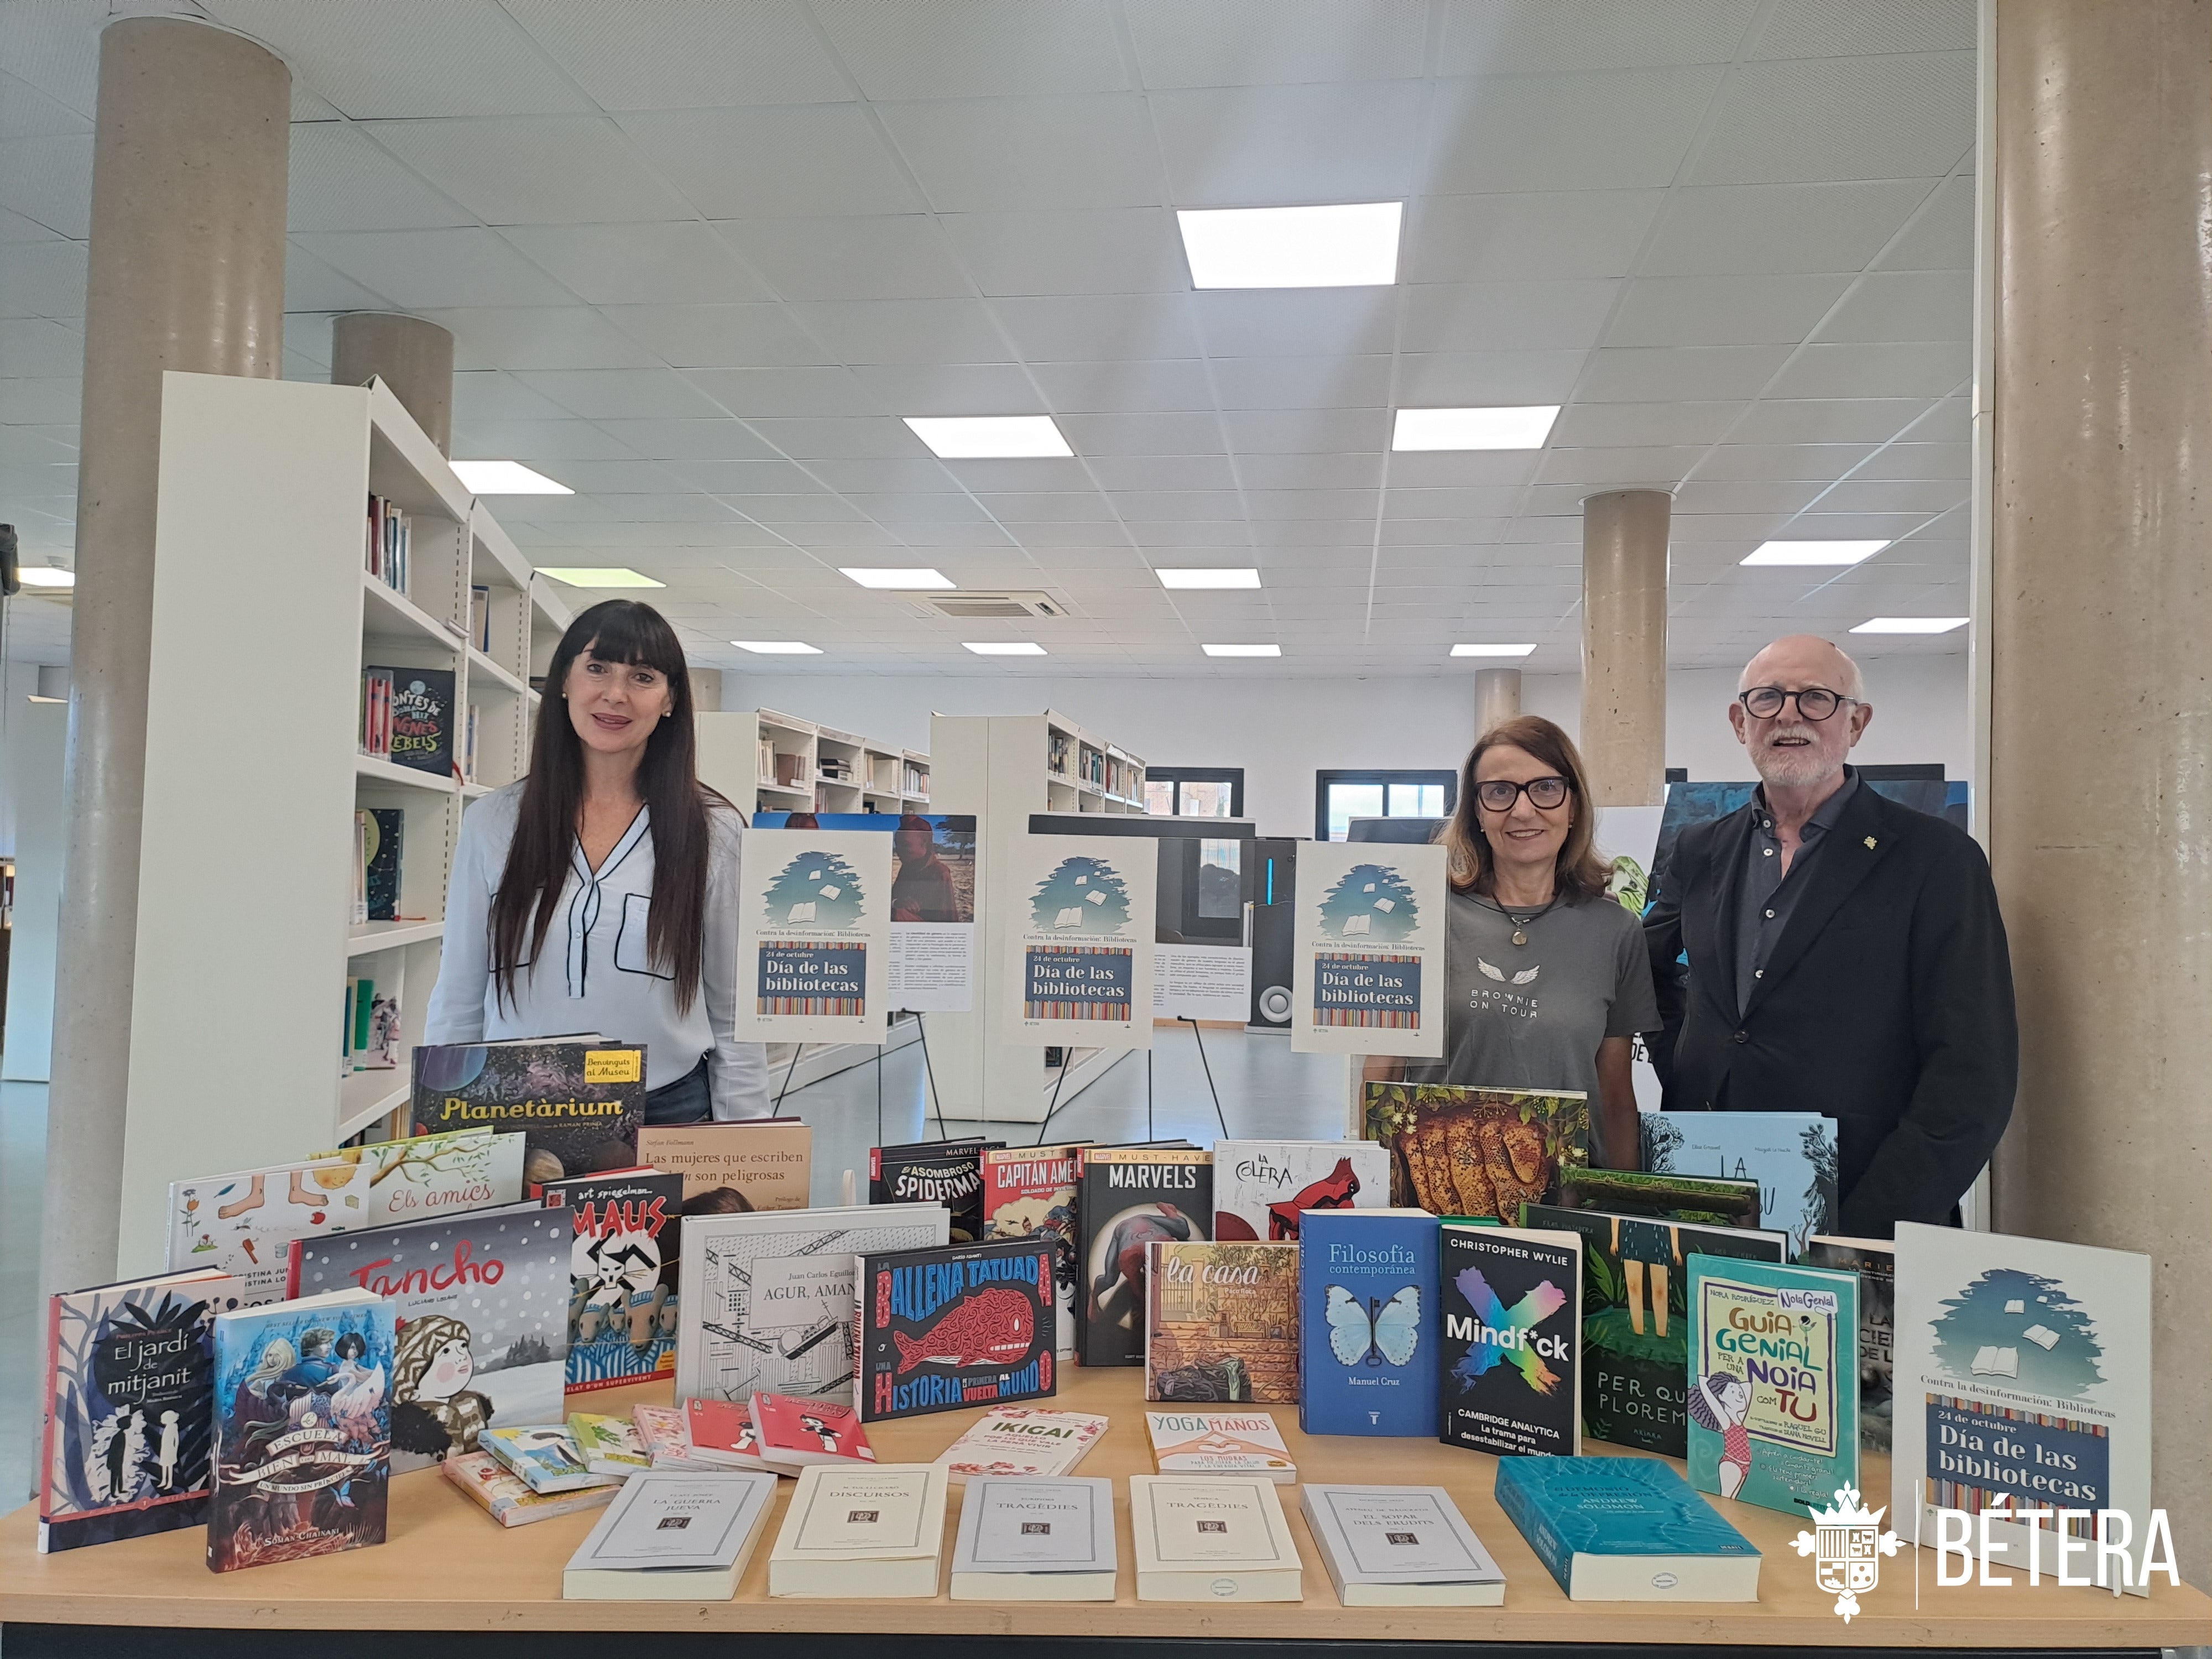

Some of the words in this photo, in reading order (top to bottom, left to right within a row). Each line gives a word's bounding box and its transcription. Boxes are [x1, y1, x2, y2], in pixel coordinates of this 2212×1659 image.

[392, 690, 429, 711] ONTES
[392, 730, 442, 752] EBELS
[766, 961, 794, 974] Día
[799, 961, 818, 974] de
[823, 961, 848, 974] las
[1034, 964, 1061, 978] Día
[1066, 966, 1085, 979] de
[1089, 966, 1114, 980] las
[766, 977, 858, 992] bibliotecas
[1323, 972, 1349, 985] Día
[1355, 973, 1374, 987] de
[1378, 974, 1403, 988] las
[1033, 982, 1124, 997] bibliotecas
[1322, 989, 1413, 1005] bibliotecas
[1472, 989, 1537, 1007] BROWNIE
[1470, 1000, 1488, 1009] ON
[1502, 1004, 1537, 1018] TOUR
[587, 1058, 630, 1068] Benvinguts
[600, 1068, 630, 1076] Museu
[440, 1097, 624, 1120] Planetàrium
[646, 1152, 666, 1164] Las
[671, 1153, 720, 1166] mujeres
[723, 1154, 747, 1166] que
[751, 1151, 803, 1162] escriben
[946, 1147, 978, 1156] MARVEL
[1259, 1153, 1268, 1165] LA
[695, 1172, 717, 1181] son
[722, 1170, 785, 1184] peligrosas
[912, 1161, 974, 1177] ASOMBROSO
[998, 1160, 1047, 1188] CAPITÁN
[1051, 1157, 1077, 1185] AMÉ
[1109, 1165, 1196, 1188] MARVELS
[389, 1190, 419, 1212] Els
[425, 1180, 495, 1207] amics
[578, 1188, 594, 1199] art
[597, 1185, 653, 1199] spiegelman
[573, 1196, 667, 1241] MAUS
[1329, 1244, 1416, 1263] Filosofía
[1451, 1238, 1528, 1259] CHRISTOPHER
[1533, 1251, 1568, 1266] WYLIE
[349, 1239, 504, 1298] Tancho
[877, 1262, 890, 1271] LA
[1167, 1256, 1197, 1283] la
[1202, 1264, 1261, 1285] casa
[1329, 1264, 1416, 1278] contemporánea
[1839, 1258, 1893, 1271] MARIE
[764, 1286, 810, 1300] AGUR,
[875, 1262, 964, 1328] BALLENA
[967, 1254, 1052, 1307] TATUADA
[1710, 1290, 1729, 1300] NORA
[1731, 1293, 1775, 1306] RODRÍGUEZ
[1870, 1313, 1892, 1328] LA
[114, 1342, 132, 1360] El
[129, 1328, 189, 1373] jardí
[1718, 1352, 1734, 1363] PER
[143, 1358, 158, 1370] de
[876, 1362, 891, 1371] UNA
[1726, 1363, 1744, 1374] UNA
[606, 1375, 651, 1387] SUPERVIVENT
[999, 1350, 1052, 1396] MUNDO
[1348, 1376, 1379, 1386] Manuel
[1381, 1376, 1400, 1387] Cruz
[108, 1368, 192, 1405] mitjanit
[874, 1372, 963, 1414] HISTORIA
[963, 1385, 999, 1402] VUELTA
[1598, 1371, 1645, 1397] PER
[1656, 1386, 1686, 1404] QU
[1757, 1395, 1777, 1405] COM
[1775, 1388, 1817, 1422] TU
[1921, 1375, 1954, 1389] Contra
[1958, 1380, 1967, 1391] la
[1970, 1383, 2052, 1407] desinformación:
[2057, 1400, 2116, 1419] Bibliotecas
[1600, 1393, 1686, 1426] PLOREM
[992, 1422, 1074, 1439] IKIGAI
[1152, 1416, 1209, 1431] YOGA
[1208, 1419, 1270, 1431] MANOS
[1458, 1408, 1510, 1427] CAMBRIDGE
[1511, 1420, 1560, 1439] ANALYTICA
[1784, 1421, 1812, 1432] RAQUEL
[1938, 1410, 1952, 1421] 24
[1954, 1412, 1968, 1424] de
[1971, 1417, 2017, 1434] octubre
[274, 1430, 343, 1451] ESCUELA
[1460, 1431, 1517, 1451] desestabilizar
[1518, 1445, 1526, 1453] el
[1481, 1424, 1490, 1433] La
[1492, 1427, 1516, 1439] trama
[1517, 1434, 1536, 1445] para
[1802, 1433, 1827, 1443] NOVELL
[1939, 1424, 1984, 1452] Día
[1993, 1437, 2026, 1460] de
[2034, 1443, 2078, 1471] las
[257, 1456, 294, 1478] BIEN
[320, 1452, 351, 1464] MAL
[1939, 1449, 2096, 1501] bibliotecas
[264, 1535, 295, 1547] SOMAN
[299, 1528, 340, 1541] CHAINANI
